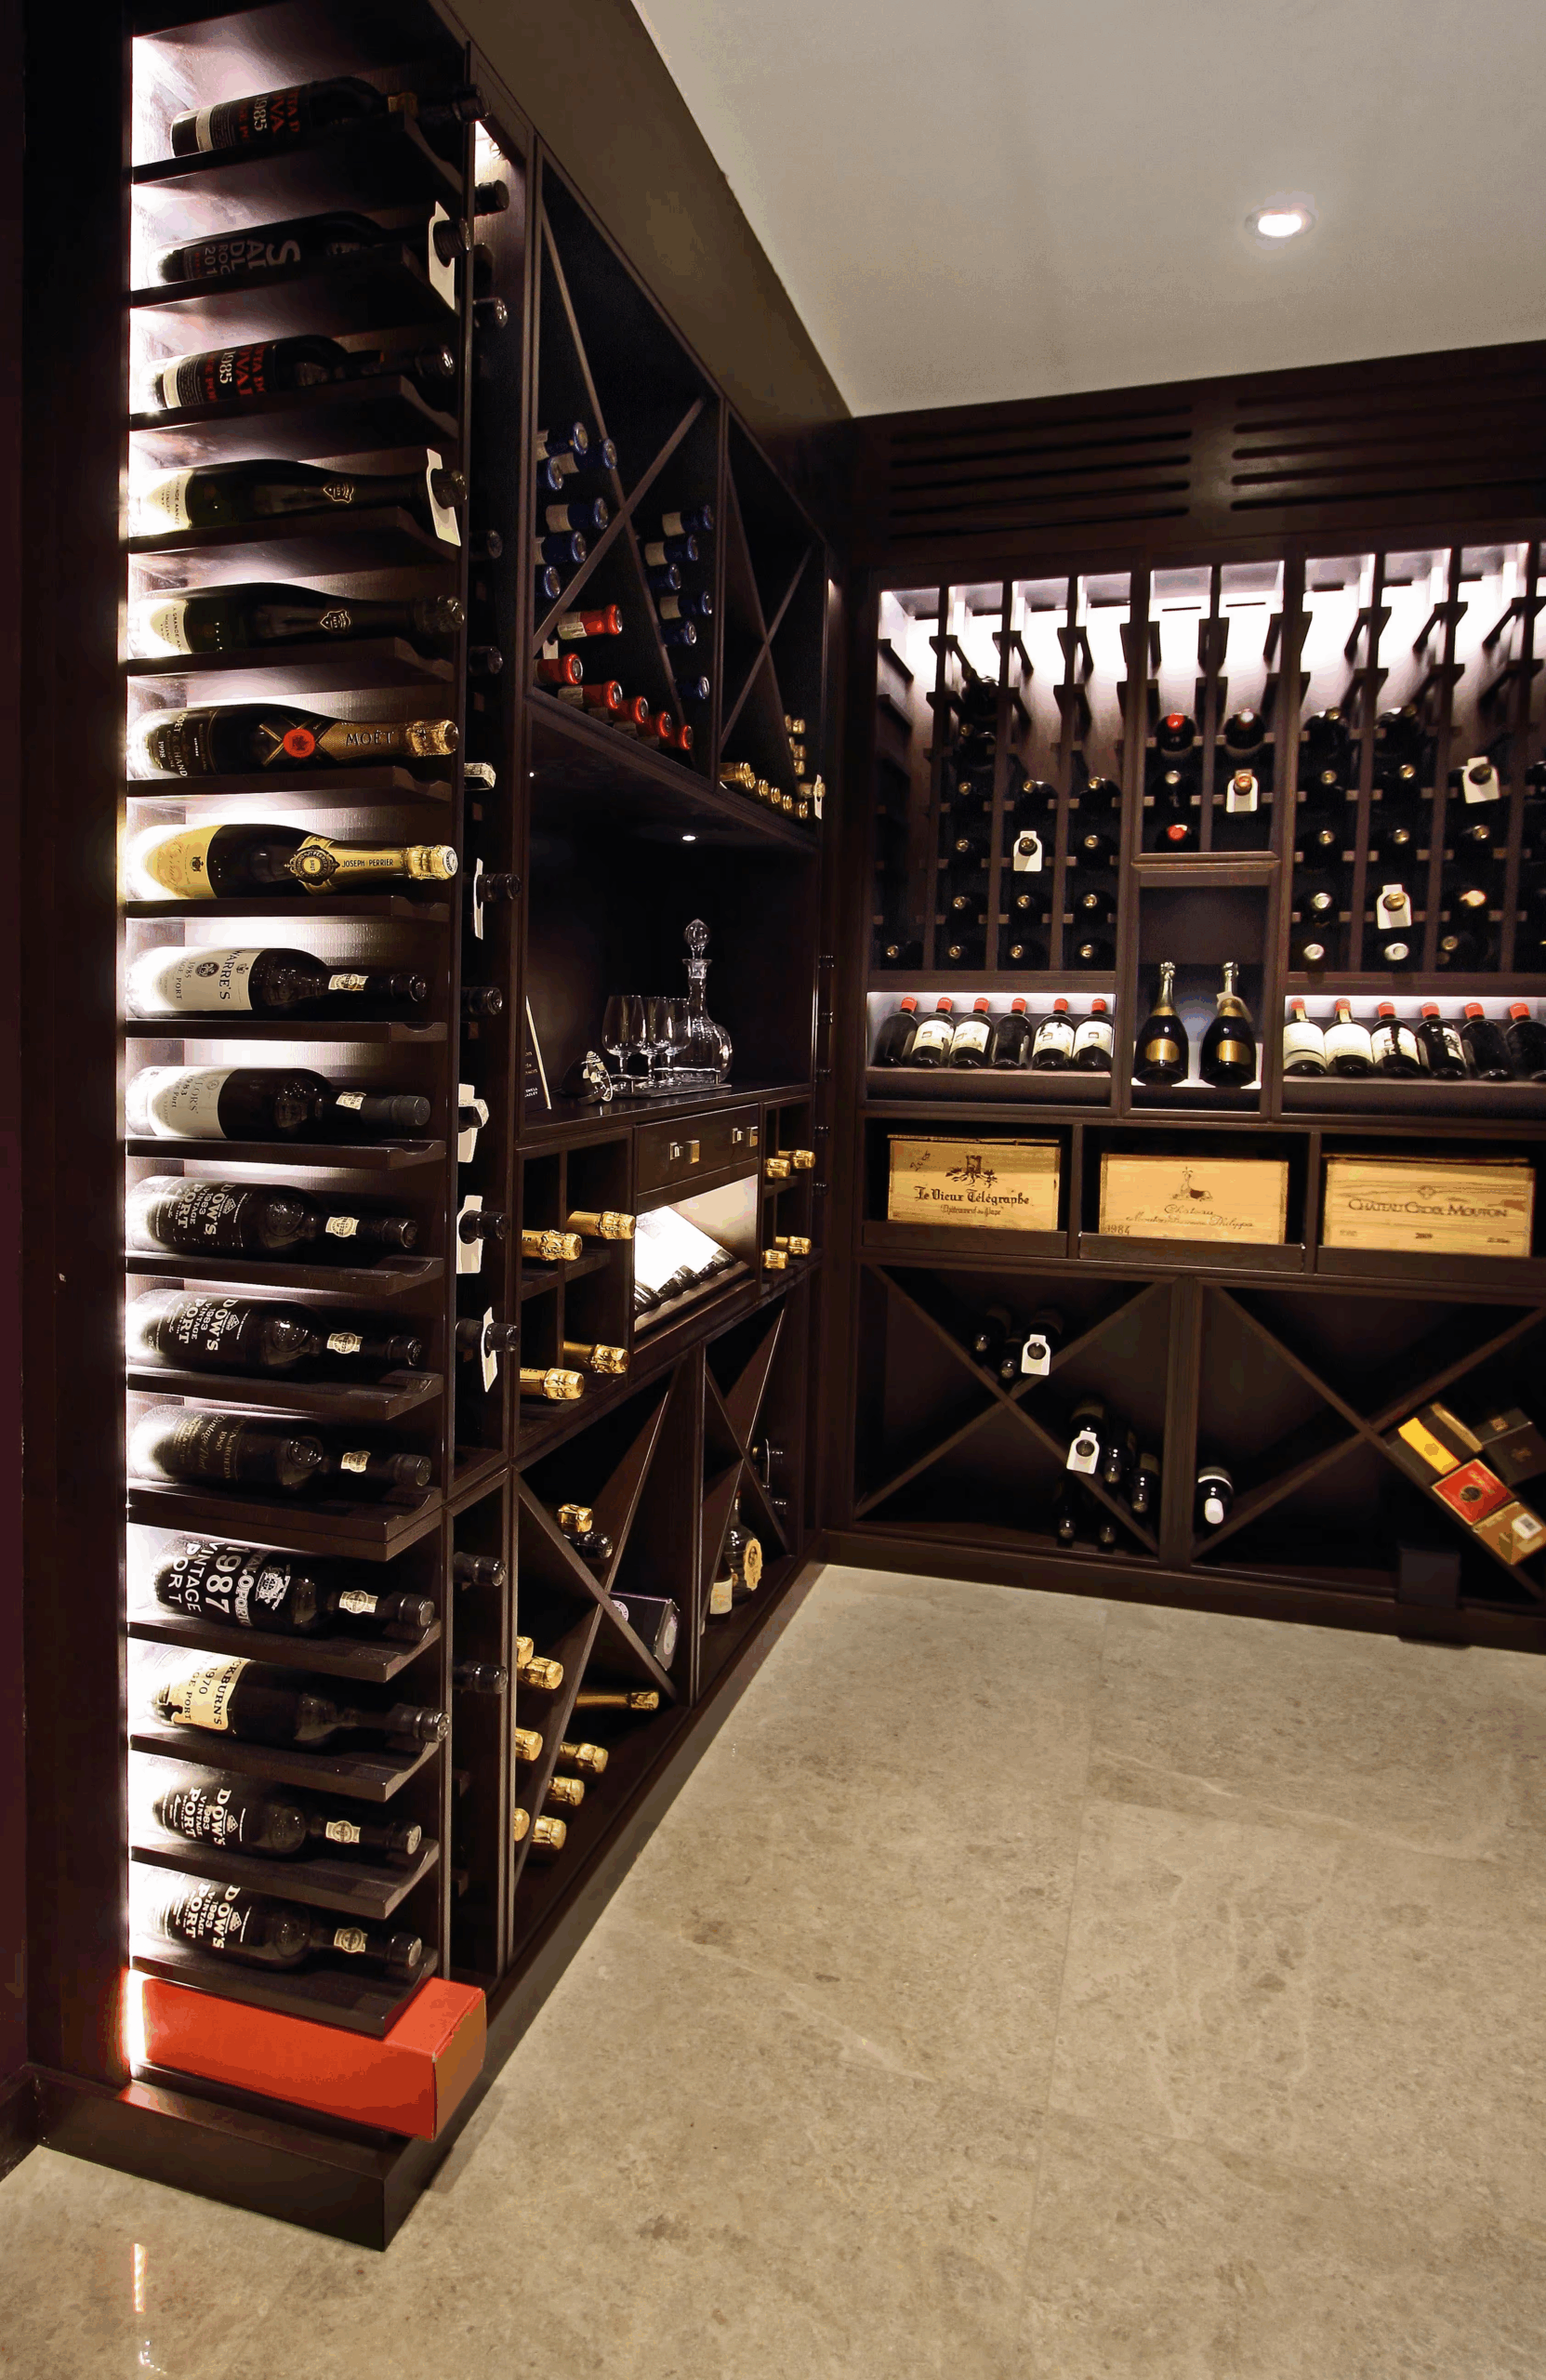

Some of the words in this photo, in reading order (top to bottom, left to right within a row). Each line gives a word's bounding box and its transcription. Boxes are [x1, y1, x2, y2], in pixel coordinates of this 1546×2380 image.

[253, 97, 269, 132] 1985
[218, 350, 236, 384] 1985
[345, 730, 394, 747] MOËT
[341, 858, 365, 868] JOSEPH
[368, 858, 394, 867] PERRIER
[185, 961, 196, 978] 1985
[218, 950, 246, 1000] WARRE'S
[171, 1091, 179, 1108] Port
[178, 1183, 206, 1228] PORT
[190, 1188, 210, 1225] VINTAGE
[198, 1193, 214, 1215] 1983
[205, 1184, 236, 1235] DOW'S
[931, 1188, 964, 1202] Vieux
[967, 1188, 1029, 1207] Télégraphe
[1447, 1204, 1508, 1218] MOUTON
[178, 1298, 207, 1343] PORT
[191, 1302, 212, 1340] VINTAGE
[200, 1308, 217, 1330] 1983
[206, 1299, 239, 1351] DOW'S
[200, 1415, 228, 1445] Vintage
[168, 1541, 202, 1604] PORT
[185, 1541, 226, 1612] VINTAGE
[205, 1546, 251, 1614] 1987
[199, 1668, 218, 1694] 1970
[184, 1691, 192, 1720] PORT
[183, 1787, 202, 1837] PORT
[196, 1795, 207, 1836] VINTAGE
[211, 1789, 231, 1845] DOW'S
[185, 1883, 211, 1938] PORT
[198, 1891, 216, 1936] VINTAGE
[205, 1901, 218, 1928] 1983
[212, 1884, 241, 1949] DOW'S
